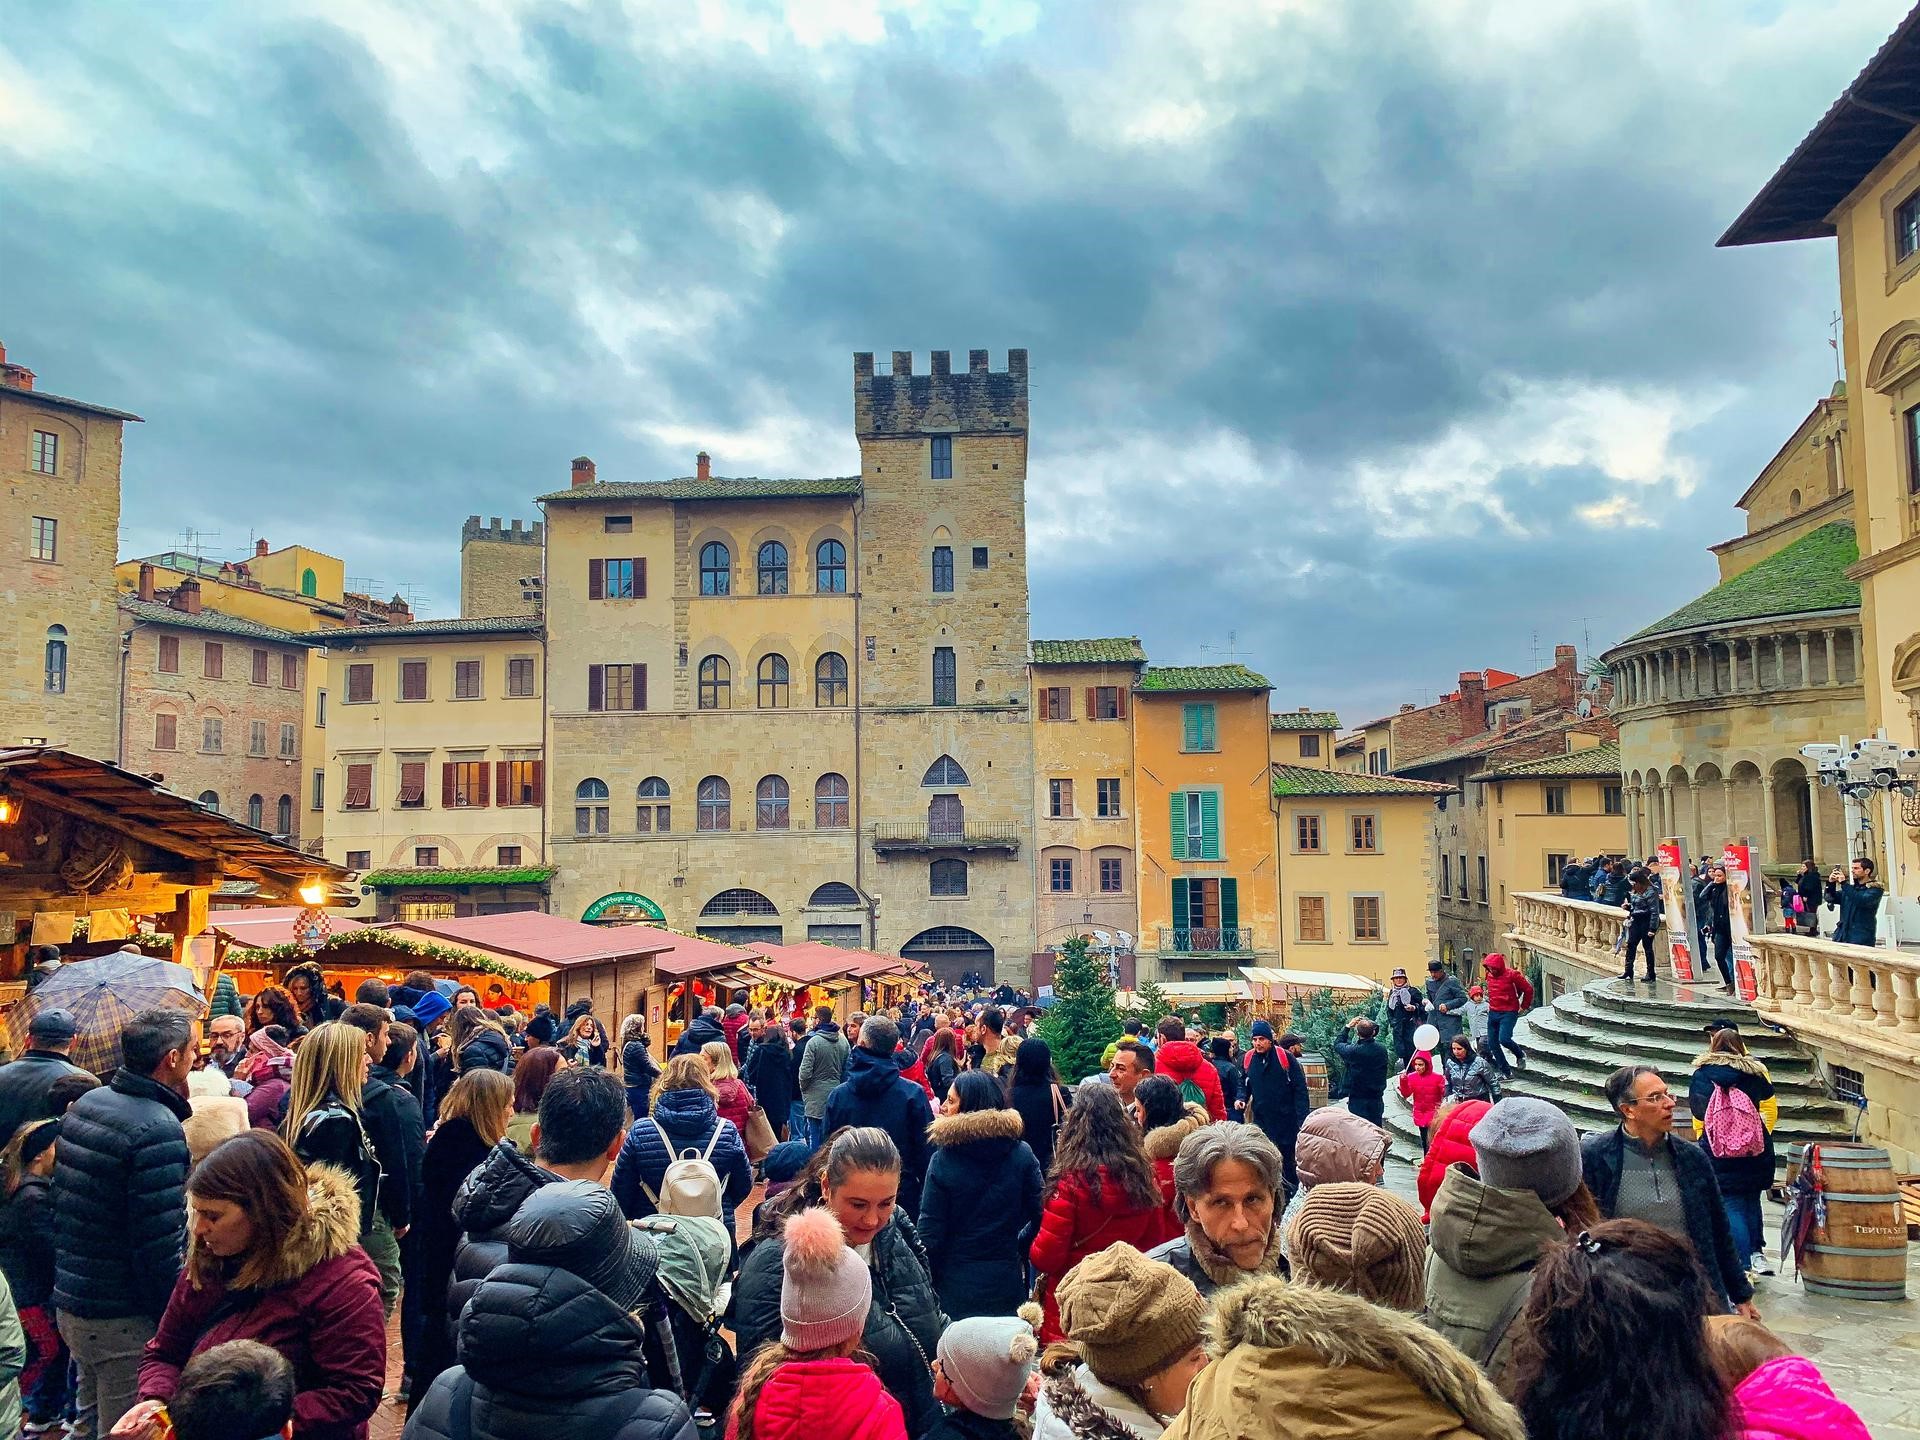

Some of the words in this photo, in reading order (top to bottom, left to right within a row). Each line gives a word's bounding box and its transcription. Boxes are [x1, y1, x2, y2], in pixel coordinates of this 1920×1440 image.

[590, 907, 600, 915] La
[599, 895, 625, 907] Bottega
[1853, 1225, 1893, 1235] TENUTA
